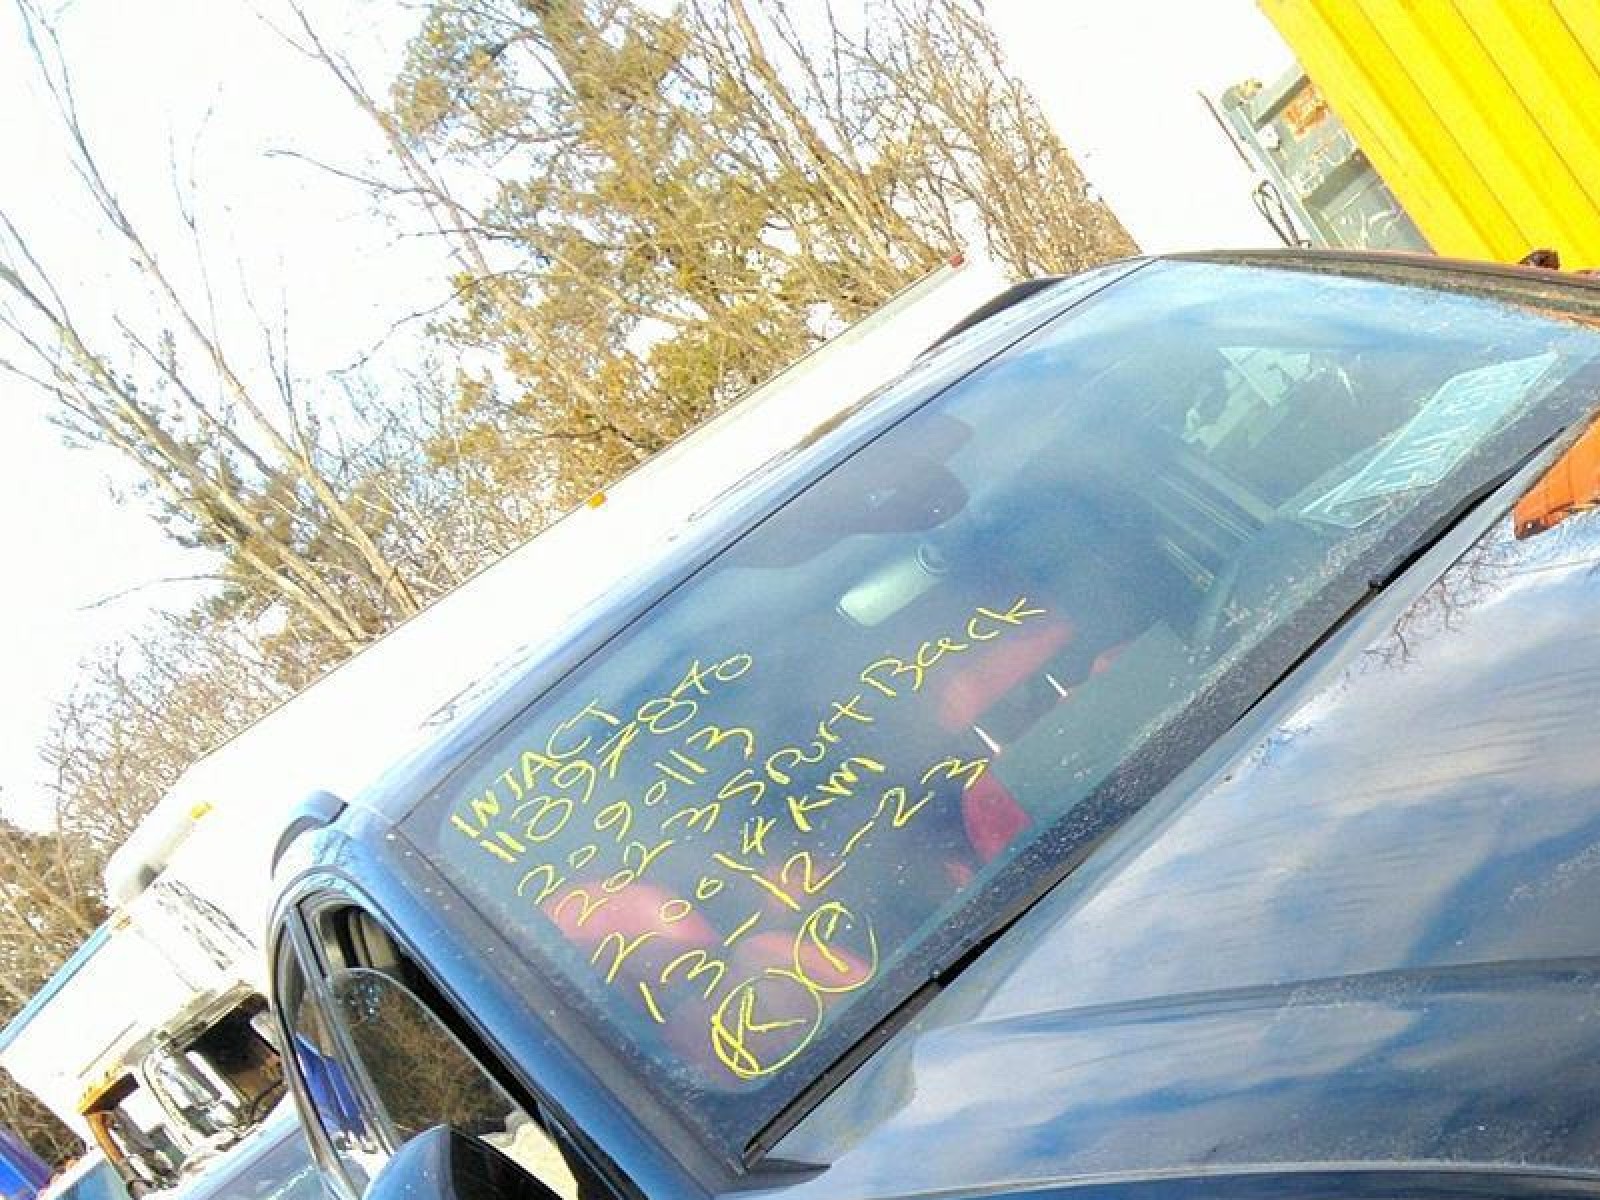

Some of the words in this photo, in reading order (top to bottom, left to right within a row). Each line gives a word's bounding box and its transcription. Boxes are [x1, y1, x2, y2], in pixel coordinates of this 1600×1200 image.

[449, 698, 621, 840] INTACT
[479, 652, 753, 863] 11897840
[517, 725, 756, 905] 2090113
